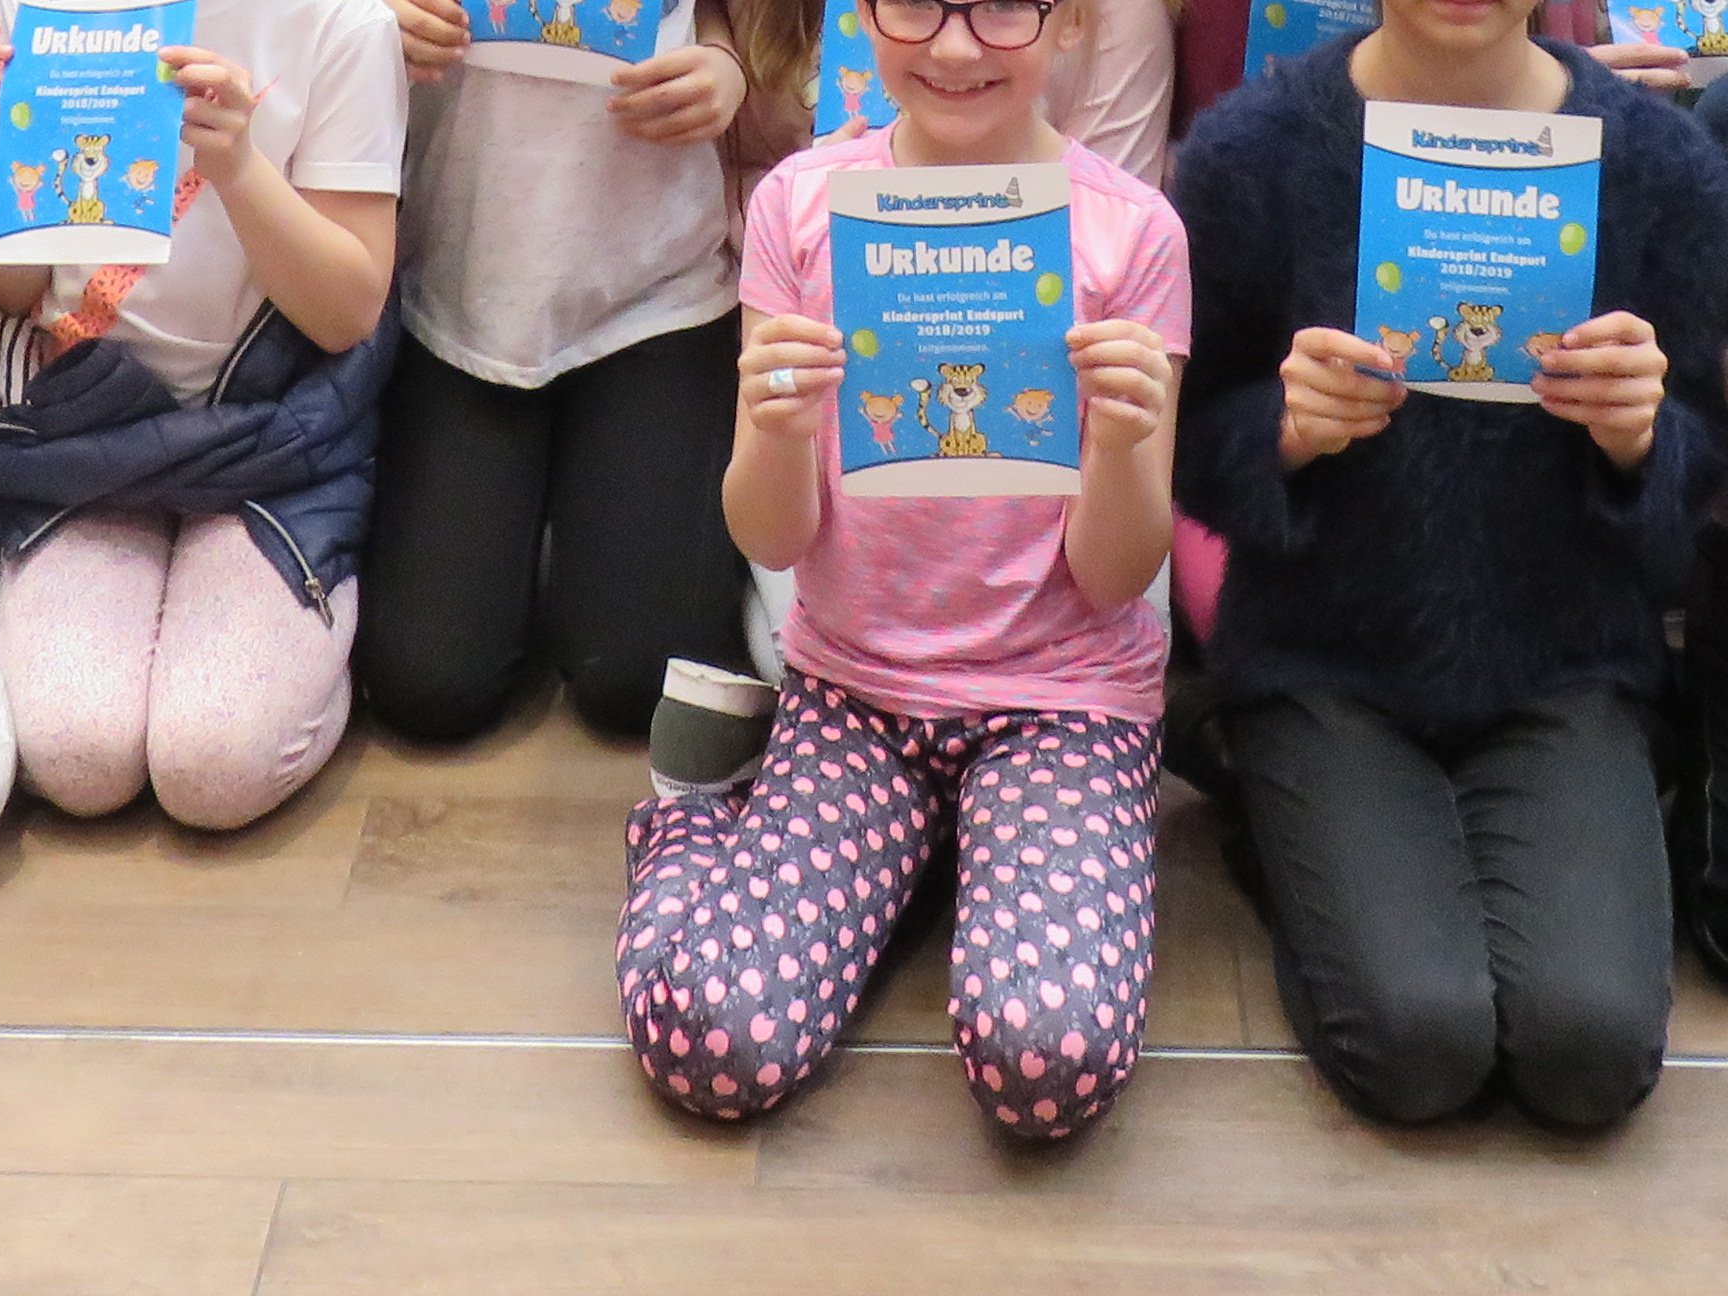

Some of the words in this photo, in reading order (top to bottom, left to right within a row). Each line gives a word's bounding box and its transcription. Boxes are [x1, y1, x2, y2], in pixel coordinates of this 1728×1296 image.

[876, 192, 1010, 212] Kindersprint
[1440, 263, 1514, 279] 2018/2019
[882, 310, 963, 325] Kindersprint
[966, 309, 1026, 325] Endspurt
[917, 323, 991, 337] 2018/2019
